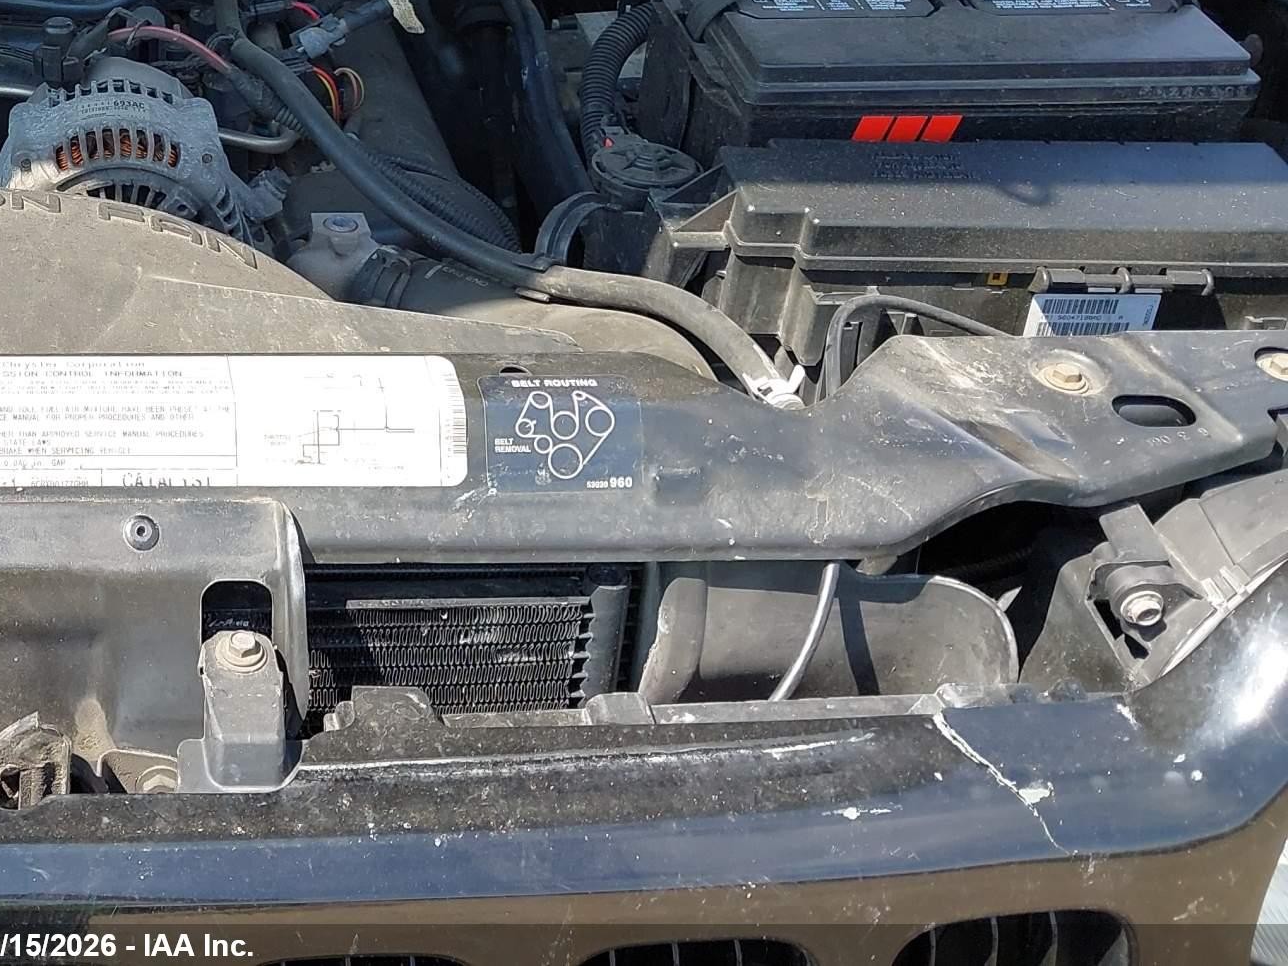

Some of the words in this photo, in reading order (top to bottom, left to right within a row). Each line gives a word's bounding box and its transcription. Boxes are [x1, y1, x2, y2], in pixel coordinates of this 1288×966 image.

[98, 207, 259, 270] FAN
[511, 379, 540, 388] BELT
[543, 379, 598, 387] ROUTING
[609, 476, 633, 488] 960
